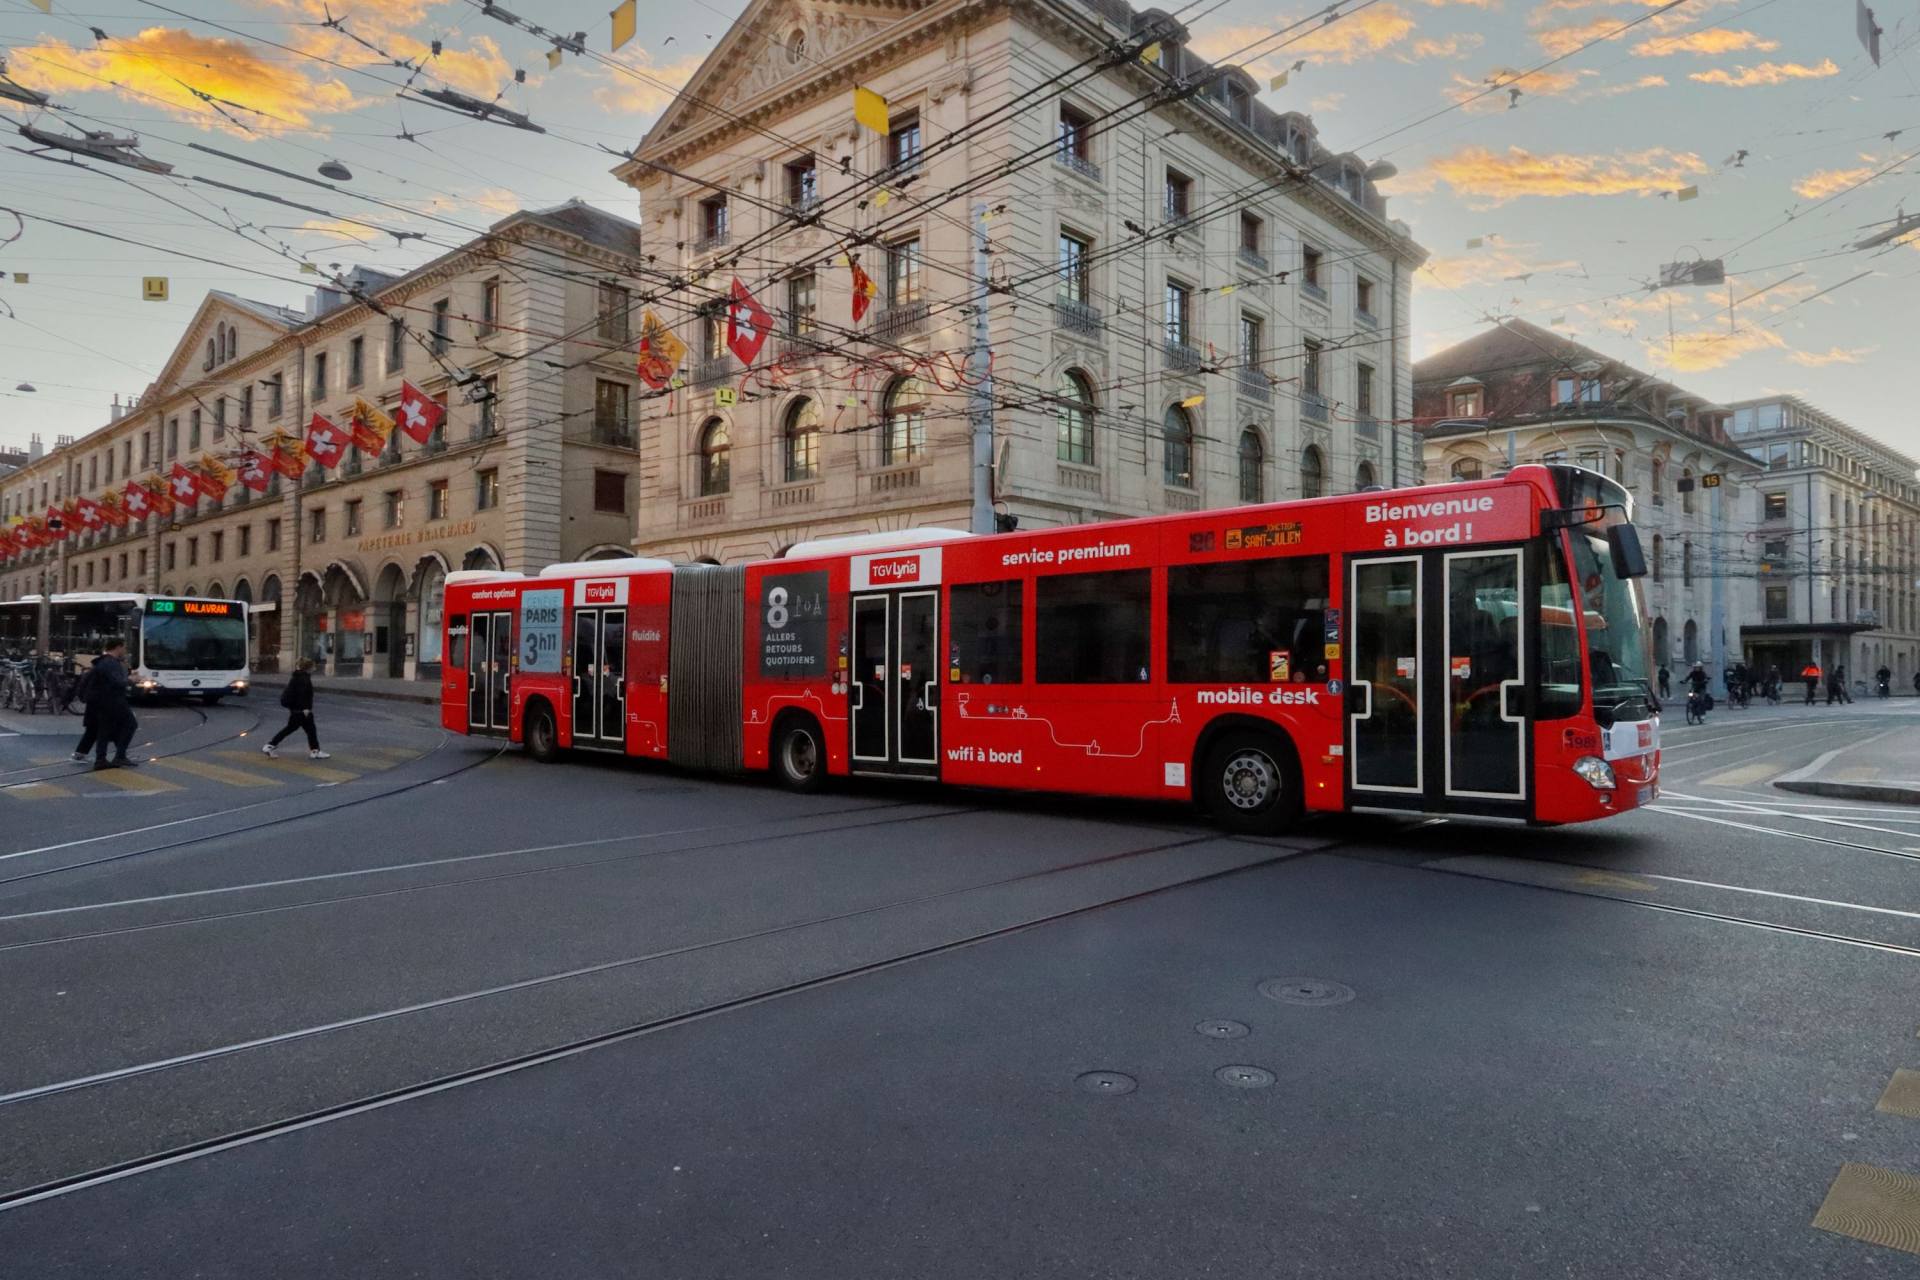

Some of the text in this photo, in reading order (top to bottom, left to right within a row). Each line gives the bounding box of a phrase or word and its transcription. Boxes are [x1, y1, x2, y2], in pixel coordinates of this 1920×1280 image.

[1704, 475, 1719, 486] 15
[1365, 496, 1494, 523] Bienvenue
[358, 521, 477, 553] PAPETERIE BRACHARD
[1244, 531, 1301, 548] SAINT-JULIEN
[1384, 529, 1397, 547] à
[1404, 523, 1460, 546] bord
[1002, 541, 1131, 566] service premium
[471, 588, 516, 601] confort optimal
[156, 601, 228, 614] 20 VALAVRAN
[767, 586, 789, 629] 8
[525, 608, 557, 623] PARIS
[447, 625, 469, 637] rapidité
[632, 630, 661, 642] fluidité
[766, 632, 796, 642] ALLERS
[765, 644, 803, 654] RETOURS
[765, 656, 815, 667] QUOTIDIENS
[1197, 686, 1319, 705] mobile desk
[947, 745, 1022, 764] wifi à bord
